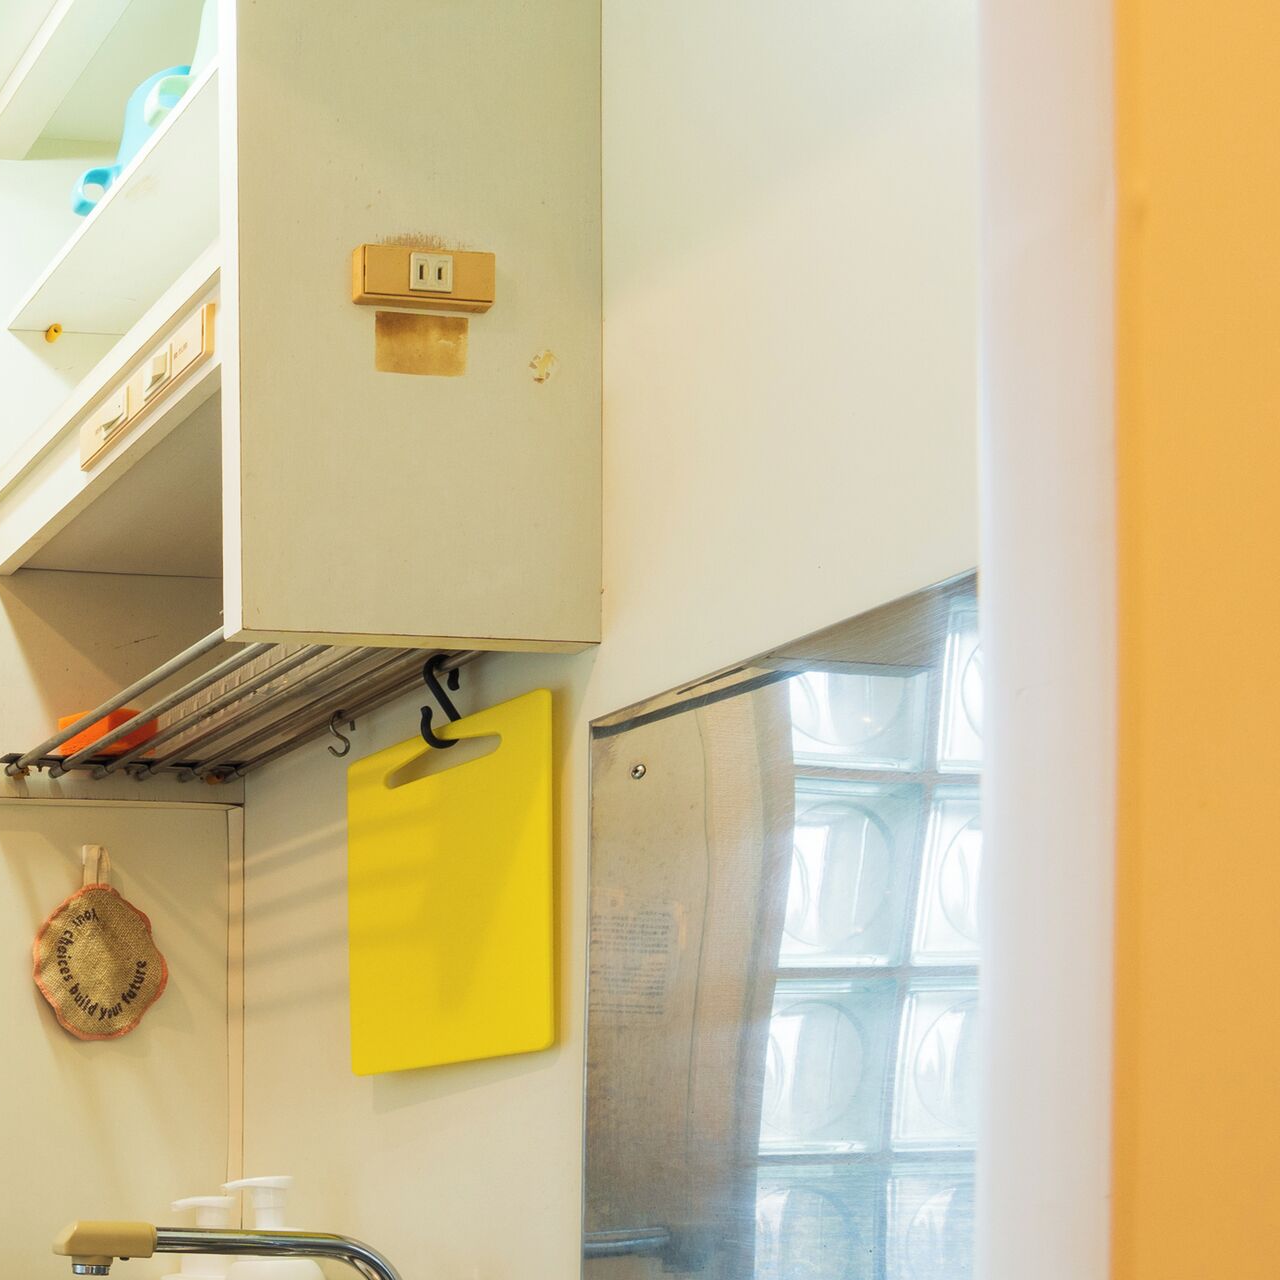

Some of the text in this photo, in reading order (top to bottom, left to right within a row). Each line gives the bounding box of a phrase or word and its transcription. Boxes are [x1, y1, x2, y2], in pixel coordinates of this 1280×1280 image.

[57, 930, 74, 981] choices
[69, 983, 98, 1017] build
[98, 1003, 122, 1021] your
[121, 961, 147, 1004] future
